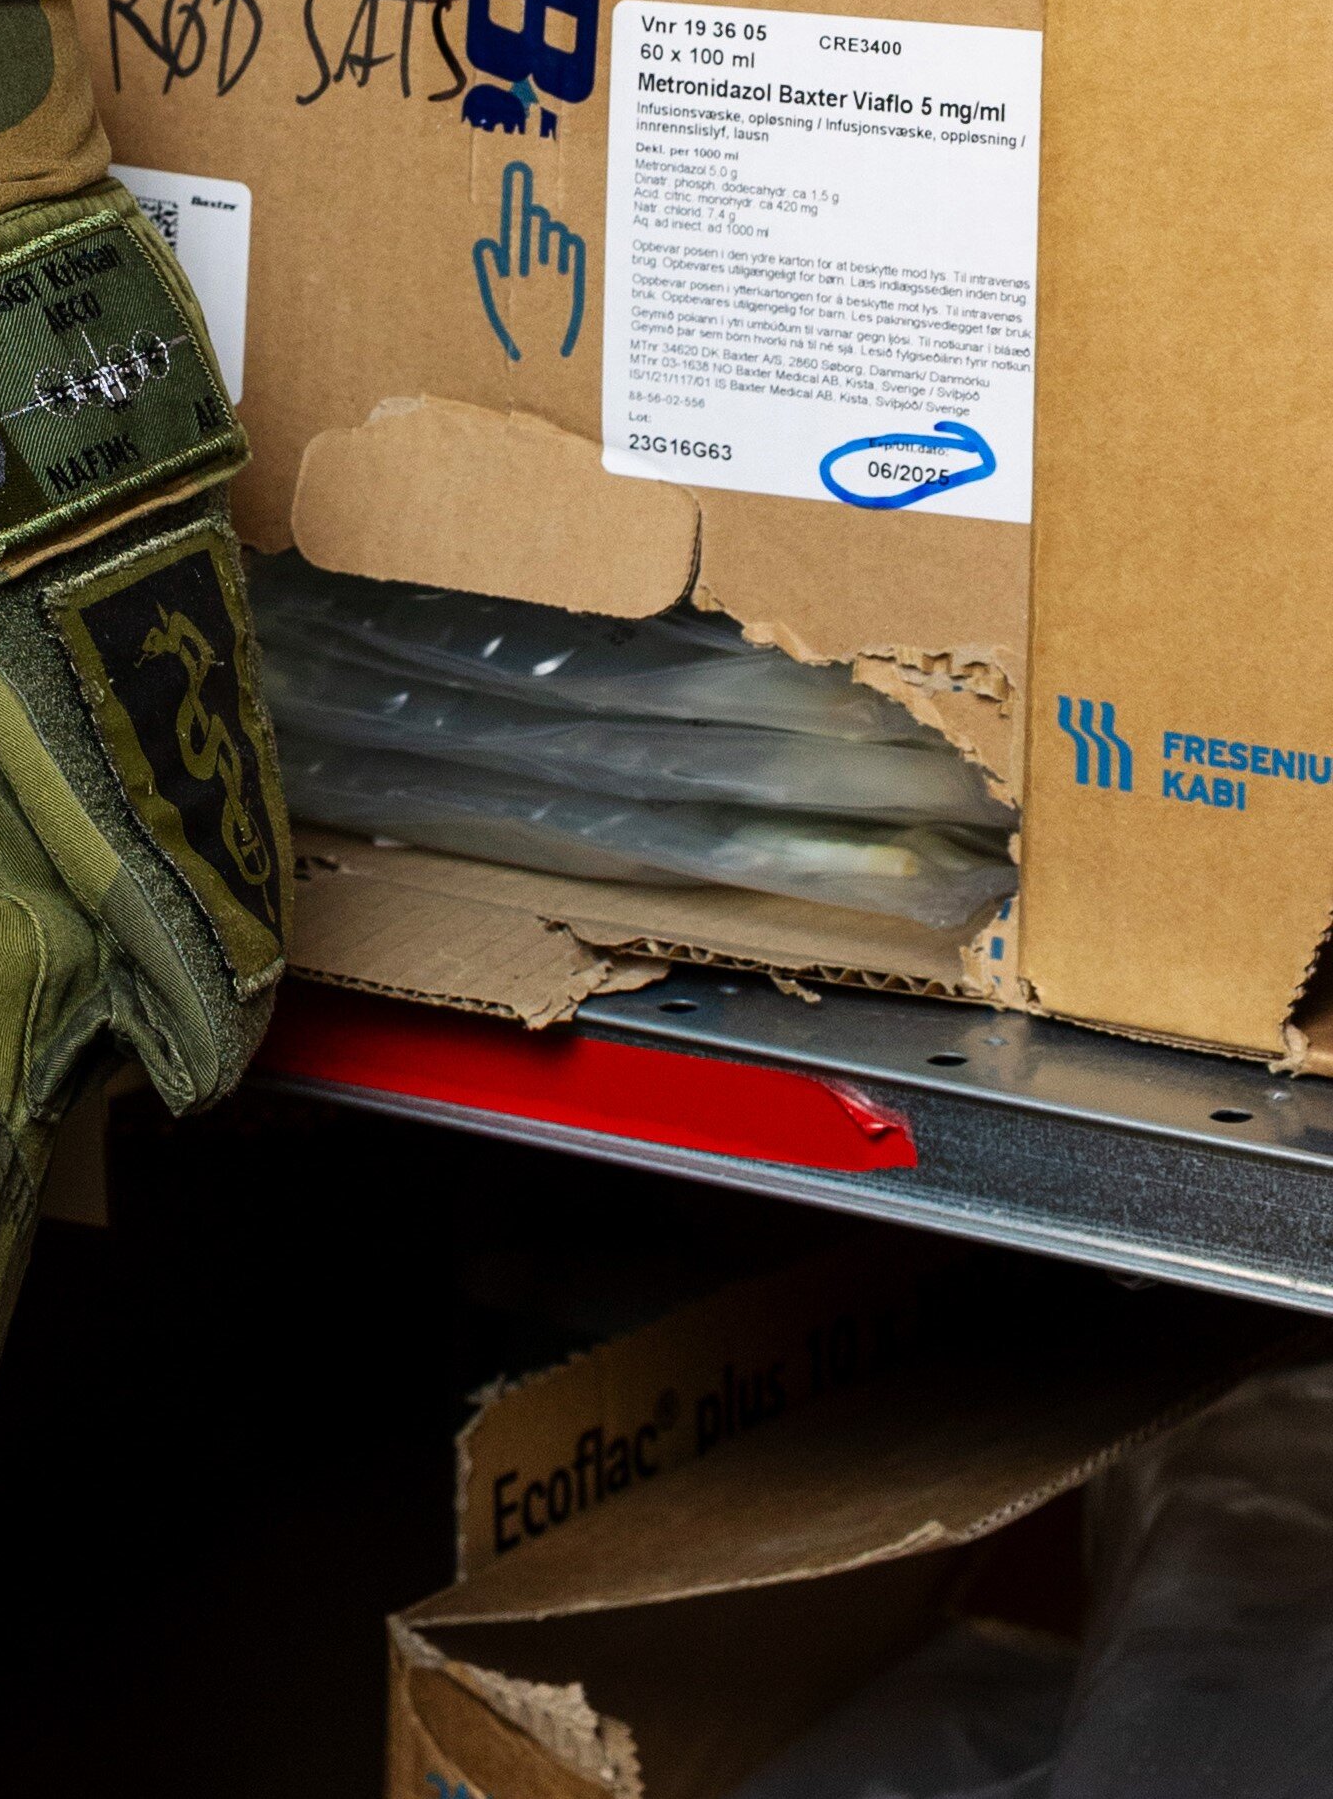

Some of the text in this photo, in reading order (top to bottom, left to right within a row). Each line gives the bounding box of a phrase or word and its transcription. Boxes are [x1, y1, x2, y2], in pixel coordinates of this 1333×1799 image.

[640, 15, 767, 41] Vnr 19 36 05
[640, 42, 755, 68] 60 x 100 ml
[818, 34, 902, 55] CRE3400
[637, 72, 1005, 127] Metronidazol Baxter Viaflo 5 mg/ml
[628, 432, 732, 462] 23G16G63
[867, 458, 951, 488] 06/2025
[1162, 770, 1246, 811] KABI
[695, 1356, 790, 1456] plus
